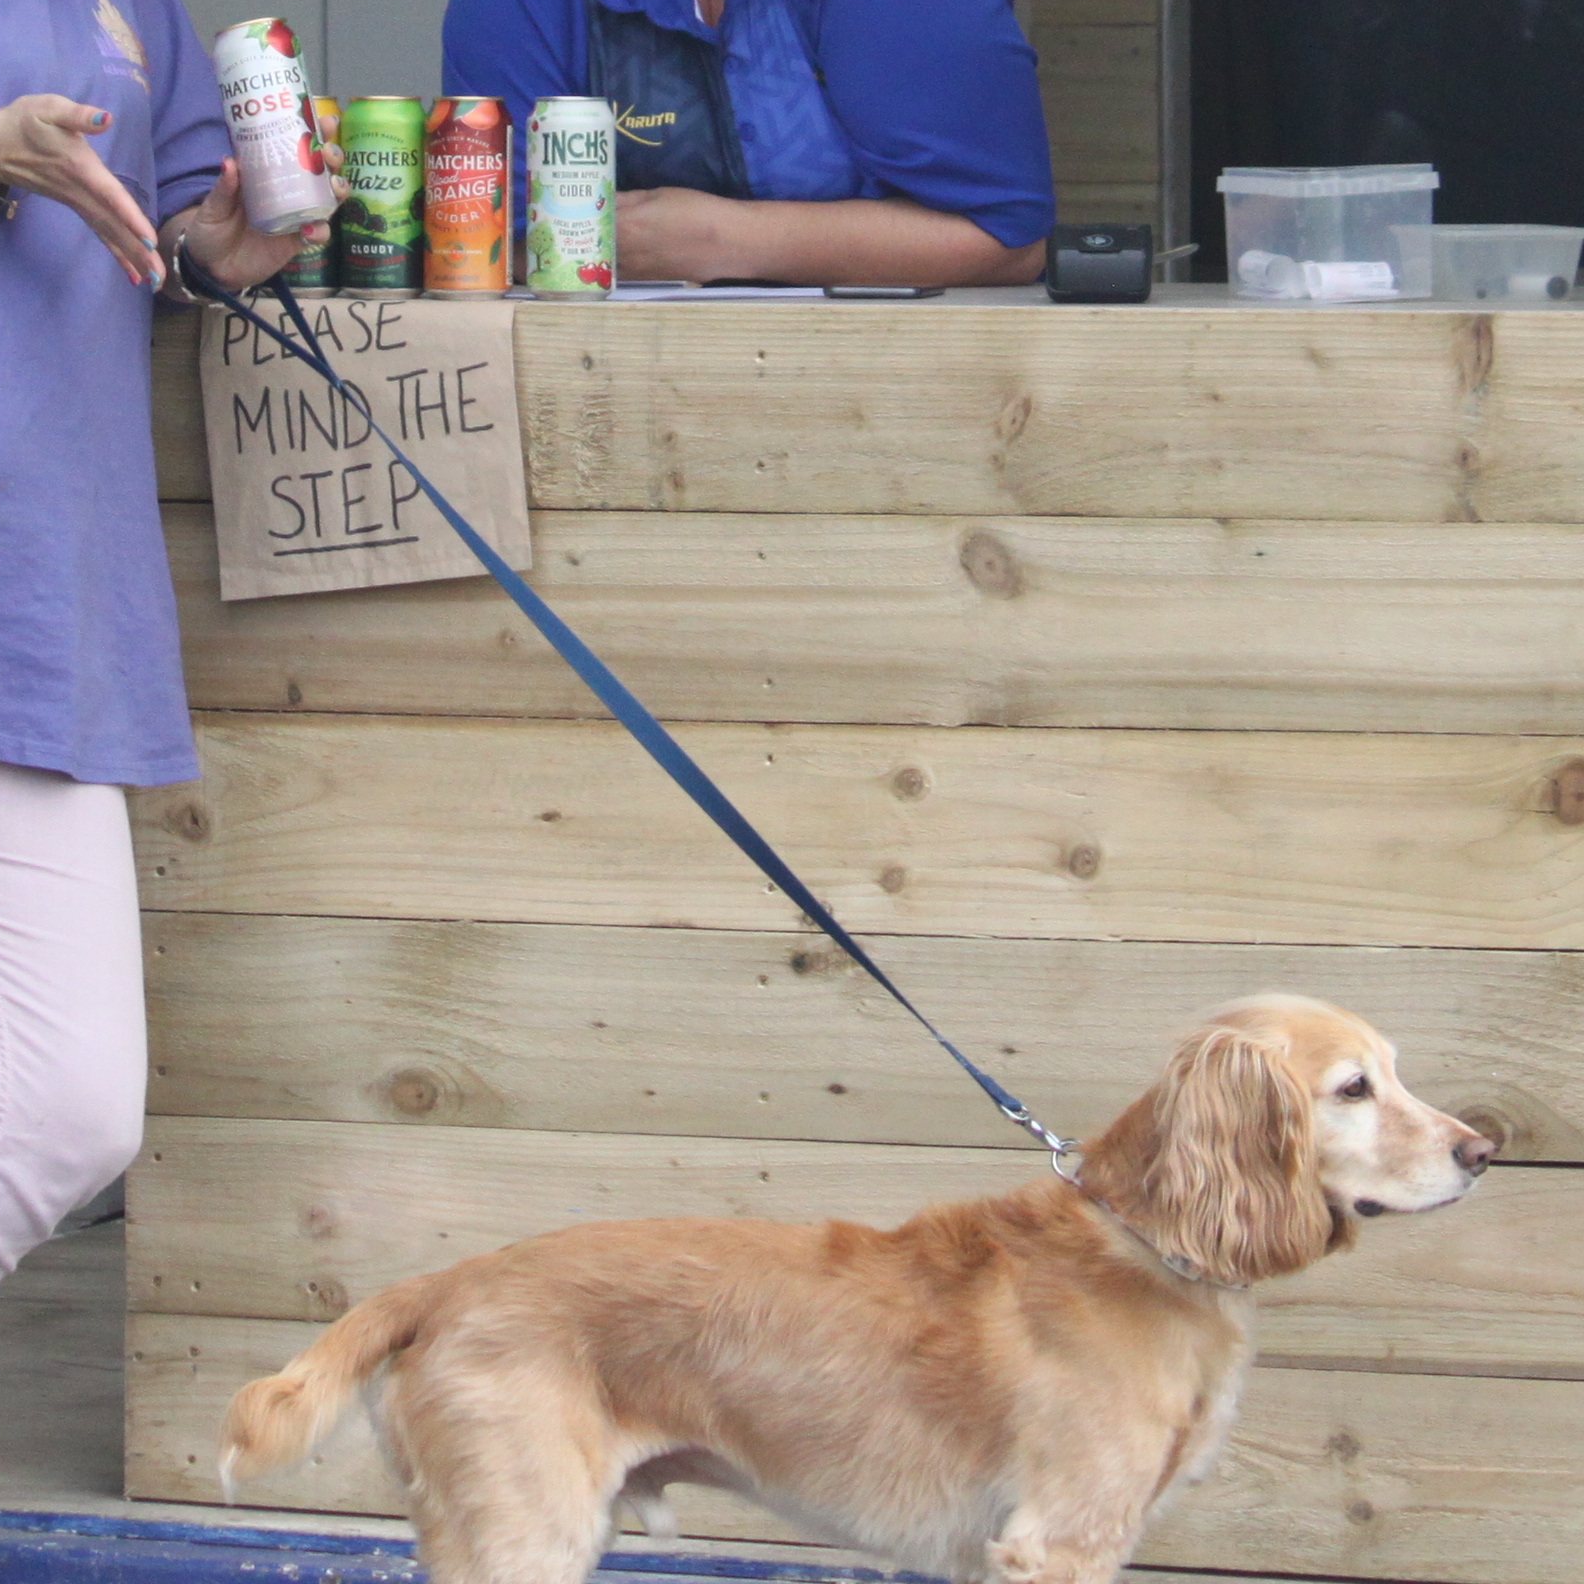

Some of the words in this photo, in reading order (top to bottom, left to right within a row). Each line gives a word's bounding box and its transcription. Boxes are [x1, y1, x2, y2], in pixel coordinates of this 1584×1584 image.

[218, 66, 301, 100] THATCHERS
[231, 87, 295, 122] ROSÉ
[344, 149, 418, 167] HATCHERS
[345, 168, 405, 191] Haze
[428, 170, 459, 188] Blood
[552, 171, 579, 179] MEDIUM
[581, 171, 599, 179] APPLE
[425, 177, 497, 205] ORANGE
[559, 184, 593, 197] CIDER
[436, 210, 480, 223] CIDER
[351, 244, 394, 255] CLOUDY
[223, 301, 407, 366] PLEASE
[233, 379, 373, 455] MIND
[386, 362, 494, 441] THE
[268, 459, 421, 539] STEP
